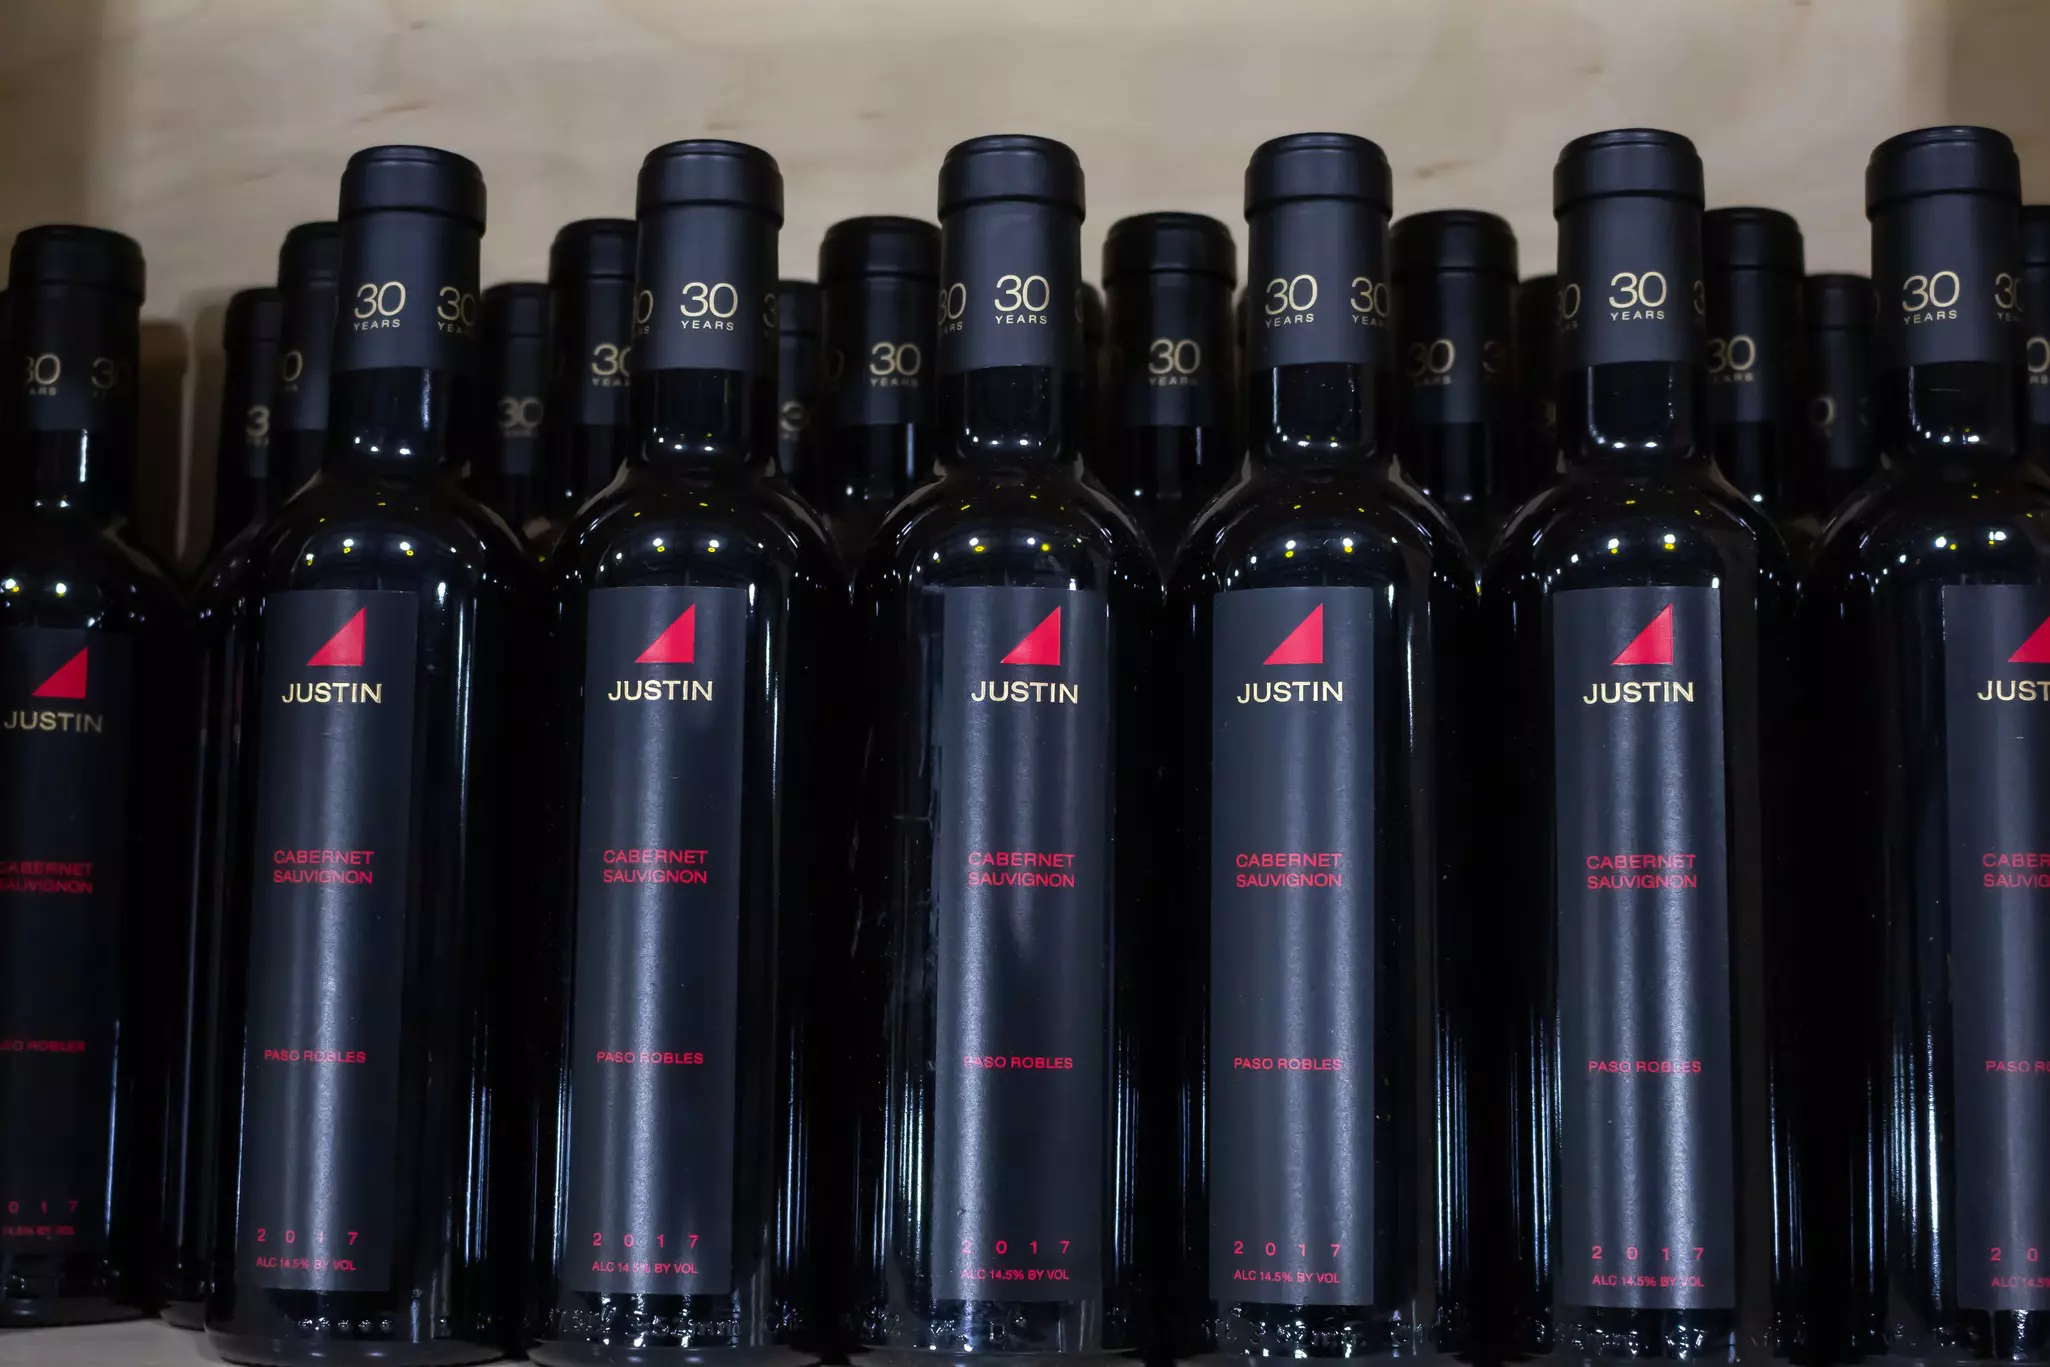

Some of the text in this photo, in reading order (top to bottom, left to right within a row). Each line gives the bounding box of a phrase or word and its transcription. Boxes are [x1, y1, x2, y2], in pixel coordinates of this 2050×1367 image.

[994, 274, 1051, 312] 30
[1264, 274, 1318, 316] 30
[1350, 276, 1391, 318] 30
[1608, 271, 1668, 309] 30
[1902, 271, 1960, 312] 30
[354, 281, 406, 319] 30
[437, 286, 477, 327] 30
[680, 282, 739, 318] 30
[995, 314, 1048, 325] YEARS
[1264, 313, 1315, 329] YEARS
[1610, 310, 1665, 321] YEARS
[1903, 309, 1958, 325] YEARS
[353, 318, 401, 332] YEARS
[681, 319, 735, 331] YEARS
[869, 341, 922, 377] 30
[1147, 336, 1202, 375] 30
[1405, 337, 1457, 377] 30
[1704, 334, 1757, 374] 30
[245, 404, 271, 437] 3
[496, 396, 545, 430] 30
[281, 682, 383, 704] JUSTIN
[607, 680, 713, 701] JUSTIN
[970, 680, 1079, 704] JUSTIN
[1236, 681, 1344, 704] JUSTIN
[1582, 681, 1695, 704] JUSTIN
[2, 711, 104, 733] JUSTIN
[273, 849, 375, 866] CABERNET
[603, 849, 708, 864] CABERNET
[967, 852, 1075, 868] CABERNET
[1236, 853, 1342, 869] CABERNET
[1586, 854, 1697, 870] CABERNET
[273, 869, 374, 885] SAUVIGNON
[602, 869, 708, 885] SAUVIGNON
[967, 872, 1075, 888] SAUVIGNON
[1236, 873, 1342, 889] SAUVIGNON
[1587, 875, 1698, 890] SAUVIGNON
[263, 1050, 368, 1064] PASO ROBLES
[596, 1052, 704, 1065] PASO ROBLES
[964, 1056, 1073, 1069] PASO ROBLES
[1234, 1058, 1342, 1071] PASO ROBLES
[1588, 1061, 1702, 1073] PASO ROBLES
[1986, 1060, 2030, 1073] PASO
[256, 1256, 277, 1269] ALC
[314, 1260, 329, 1271] BY
[333, 1259, 358, 1272] VOL
[591, 1261, 615, 1273] ALC
[654, 1263, 671, 1275] BY
[673, 1263, 699, 1275] VOL
[961, 1268, 987, 1280] ALC
[1027, 1269, 1044, 1281] BY
[1046, 1269, 1070, 1281] VOL
[1233, 1269, 1257, 1281] ALC
[1296, 1271, 1314, 1284] BY
[1316, 1272, 1341, 1284] VOL
[1592, 1275, 1617, 1287] ALC
[1659, 1275, 1677, 1288] BY
[1678, 1276, 1705, 1288] VOL
[1991, 1275, 2019, 1288] ALC
